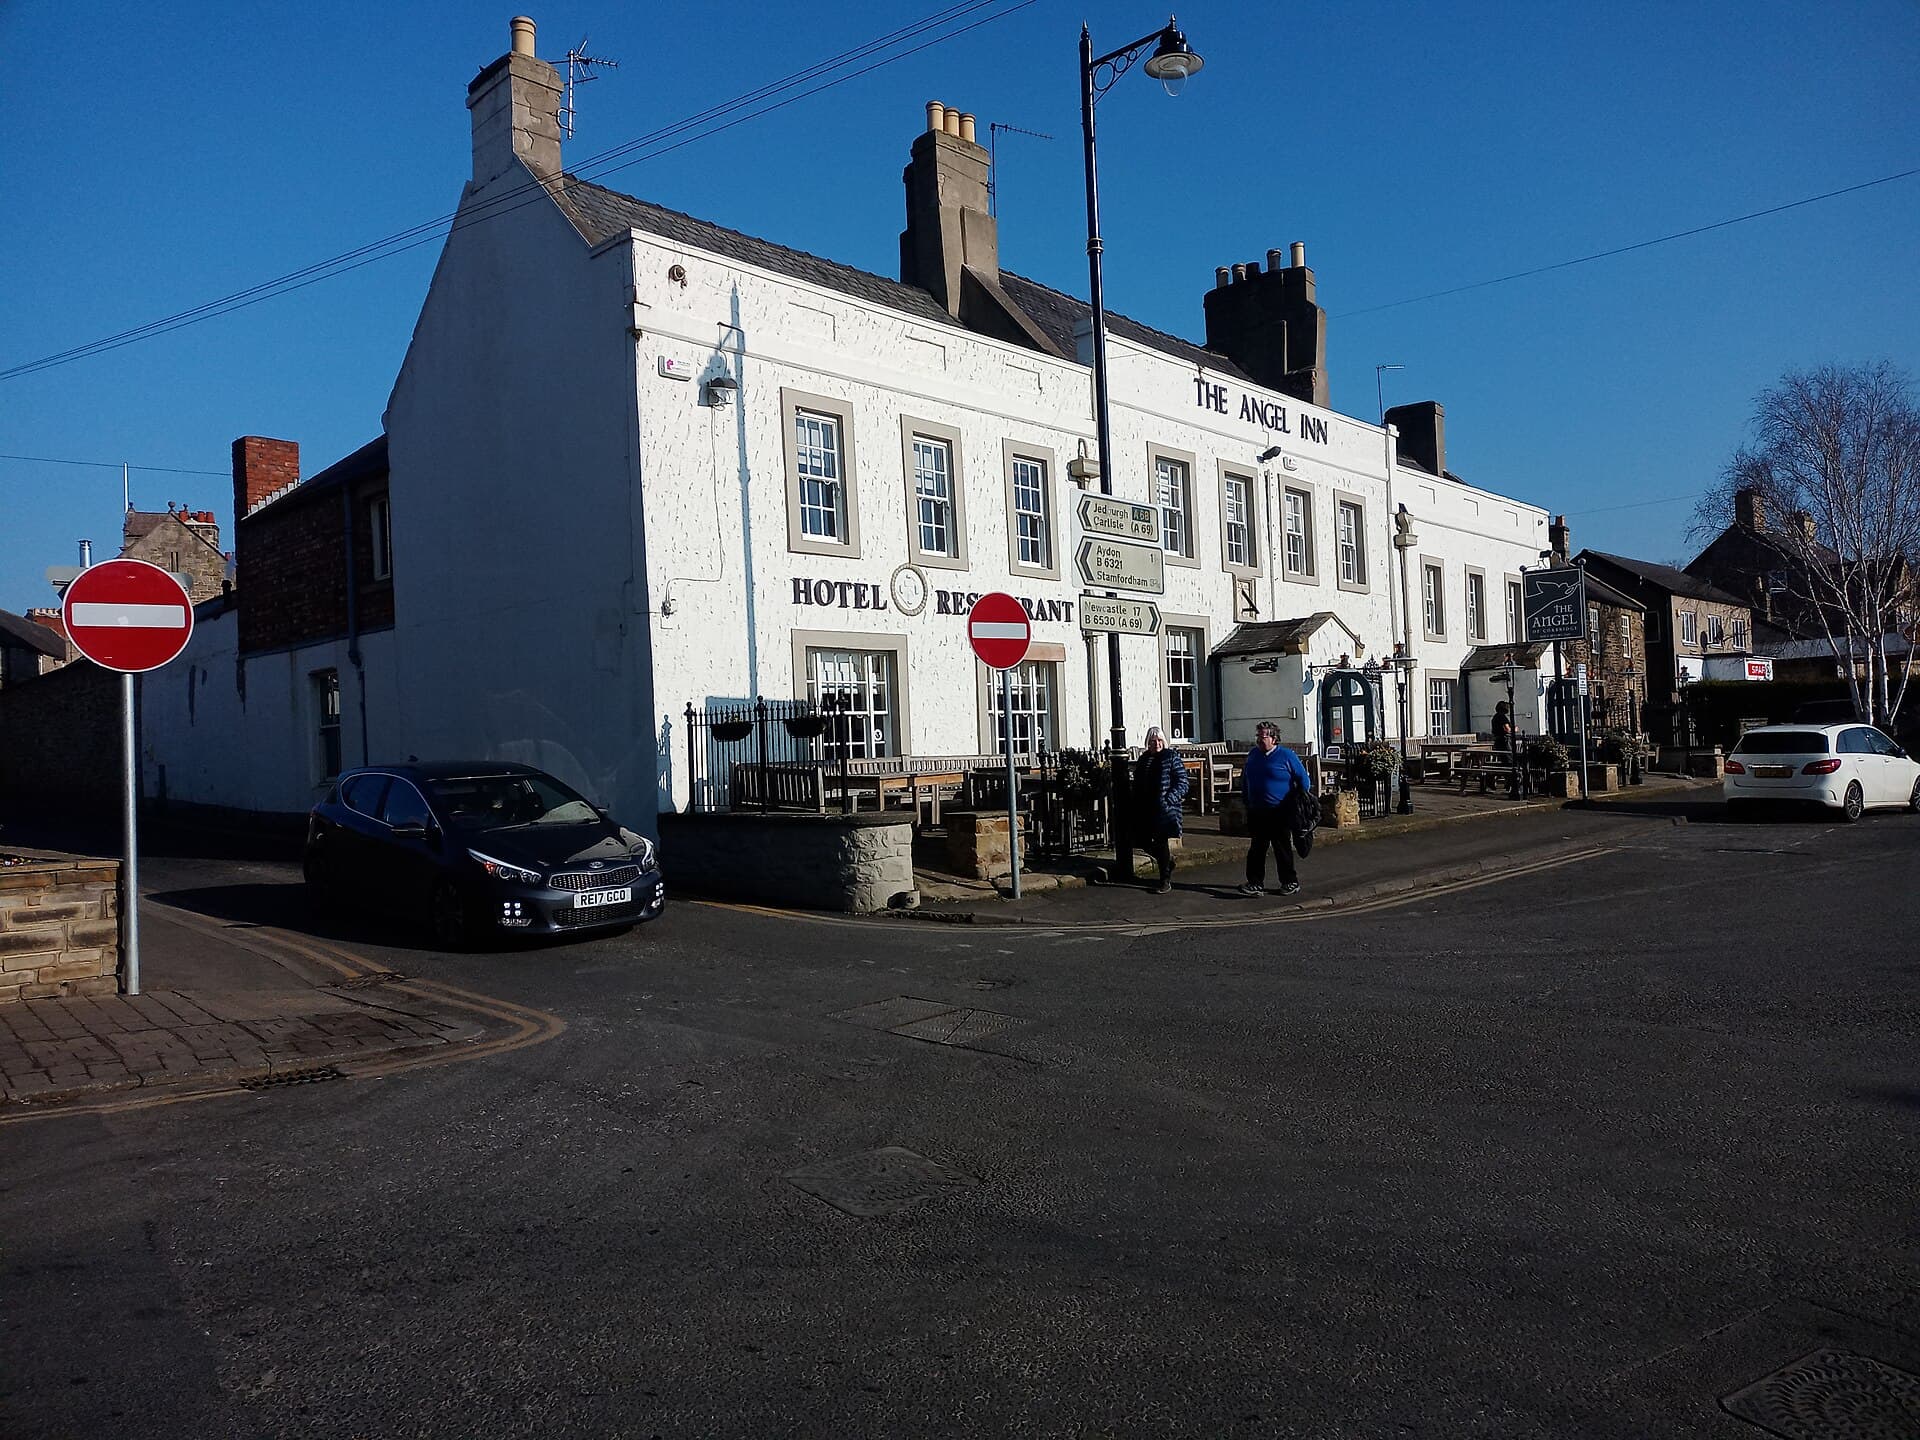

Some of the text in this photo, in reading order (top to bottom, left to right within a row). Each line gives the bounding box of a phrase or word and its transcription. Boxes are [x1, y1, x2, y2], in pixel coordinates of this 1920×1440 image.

[1194, 378, 1328, 445] THE ANGEL INN
[1093, 516, 1124, 530] Carlisle
[1141, 524, 1153, 535] 69)
[1096, 545, 1121, 558] Aydon
[1096, 557, 1123, 570] B 6321
[1096, 571, 1148, 587] Stamfordham
[791, 577, 1074, 622] HOTEL RESRANT
[1084, 601, 1141, 617] Newcastle 17
[1553, 604, 1573, 613] THE
[1084, 614, 1143, 630] B 6530 (A 69)
[1532, 614, 1578, 628] ANGEL
[581, 890, 626, 905] RE17 GCO
